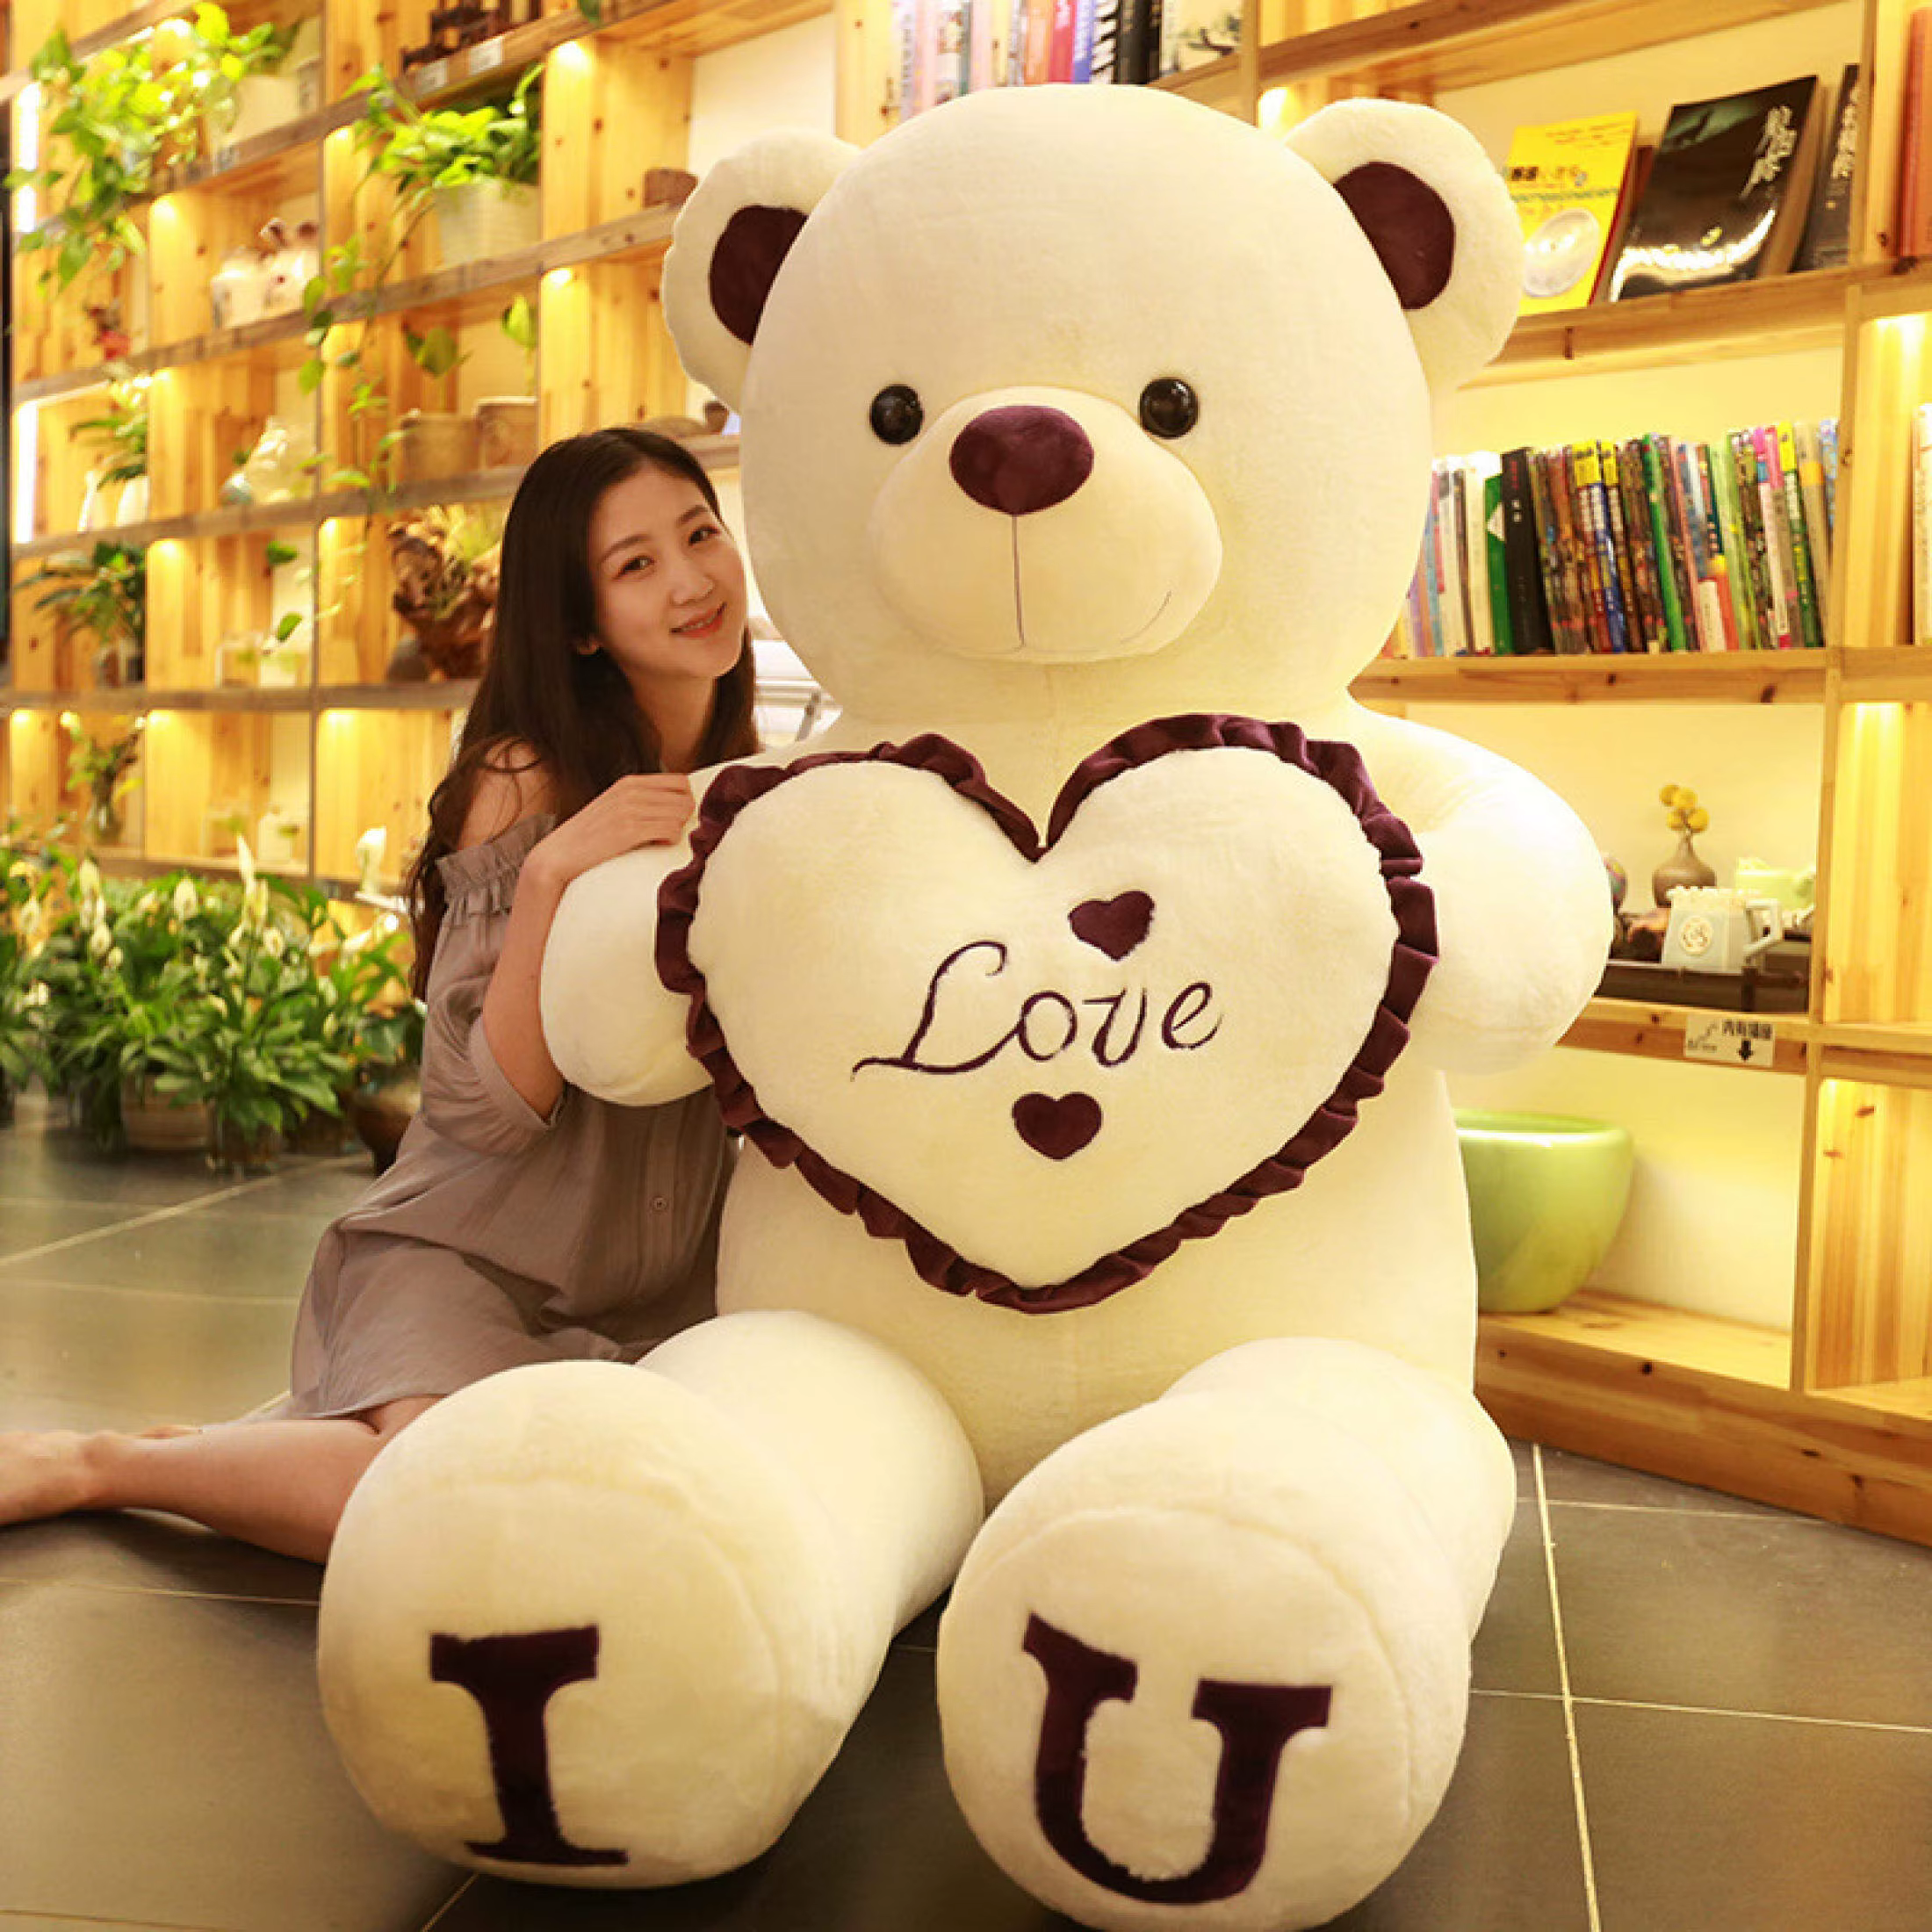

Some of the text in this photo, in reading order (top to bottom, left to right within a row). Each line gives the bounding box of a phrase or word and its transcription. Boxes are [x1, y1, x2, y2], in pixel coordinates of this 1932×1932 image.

[850, 941, 1224, 1082] Love
[429, 1625, 629, 1866] I
[1023, 1611, 1331, 1905] U
